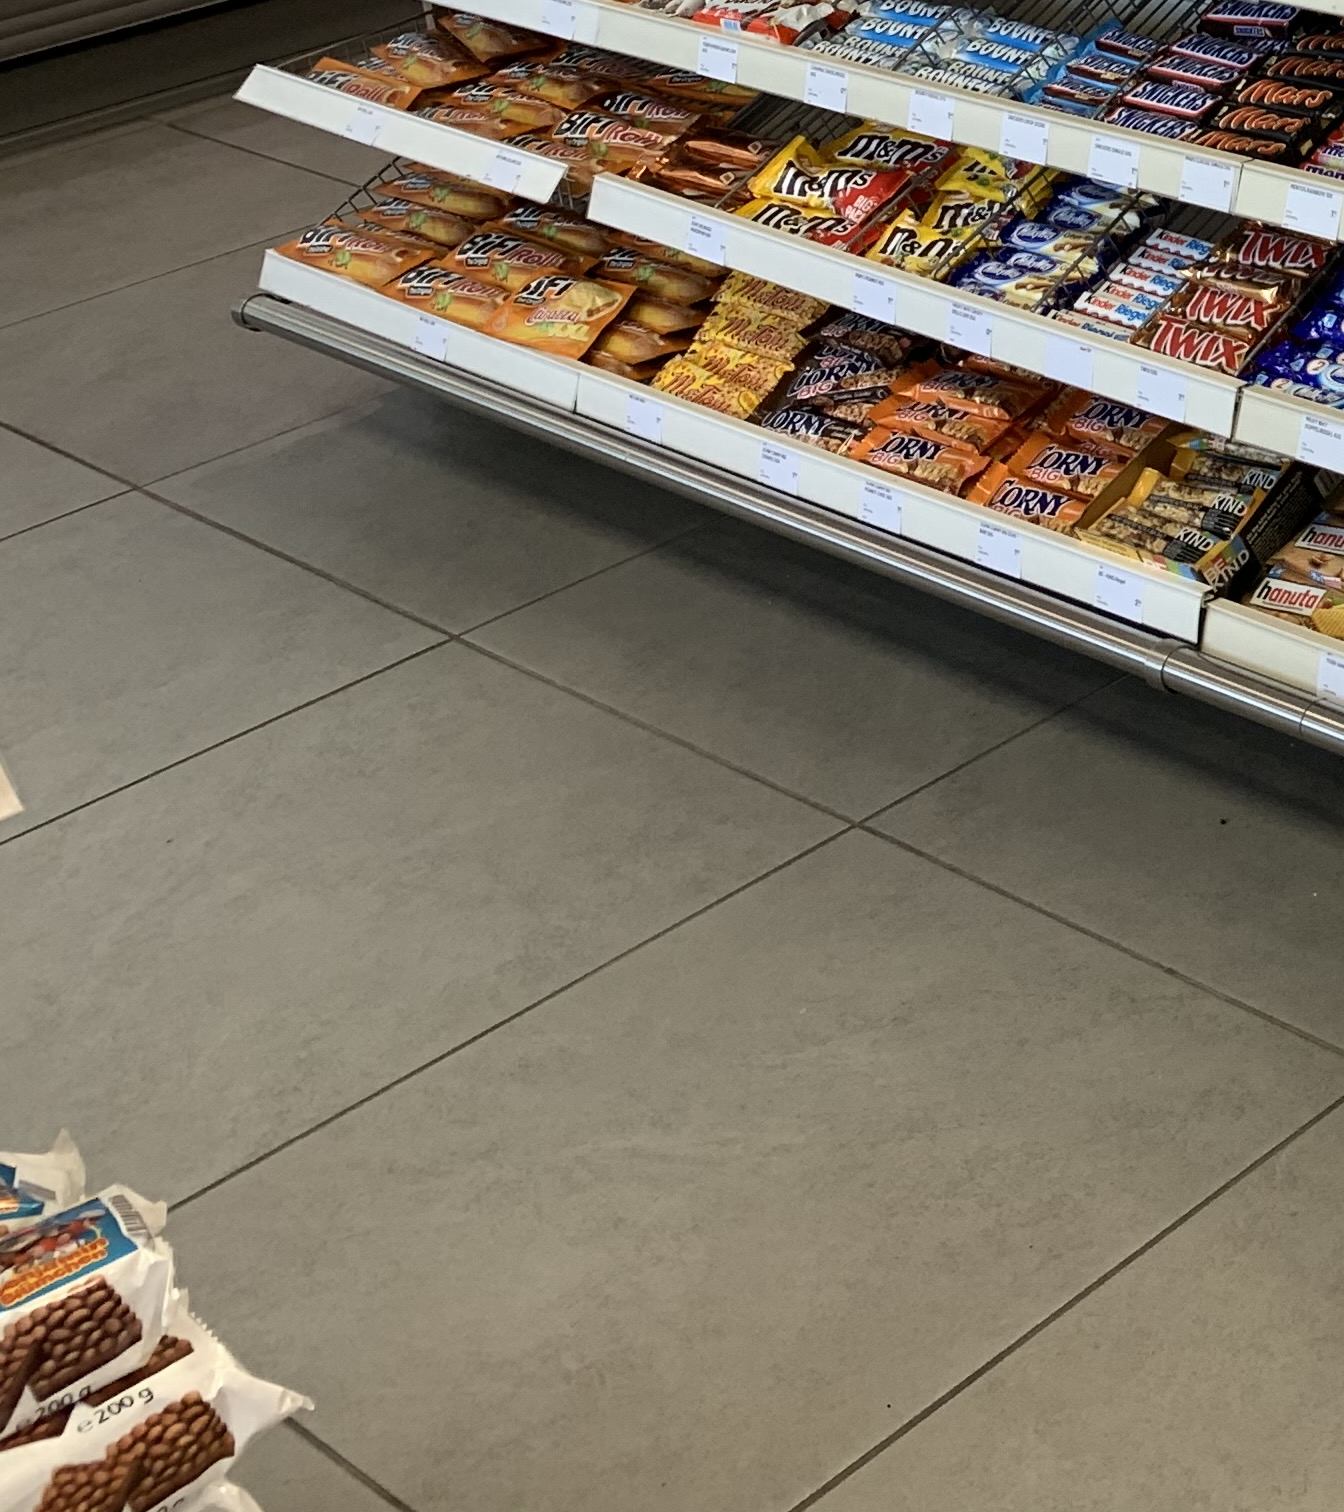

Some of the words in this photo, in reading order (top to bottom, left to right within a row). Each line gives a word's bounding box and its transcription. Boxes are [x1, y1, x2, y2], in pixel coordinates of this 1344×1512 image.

[875, 435, 944, 463] CORNY
[93, 1397, 135, 1425] 200
[138, 1387, 155, 1403] g
